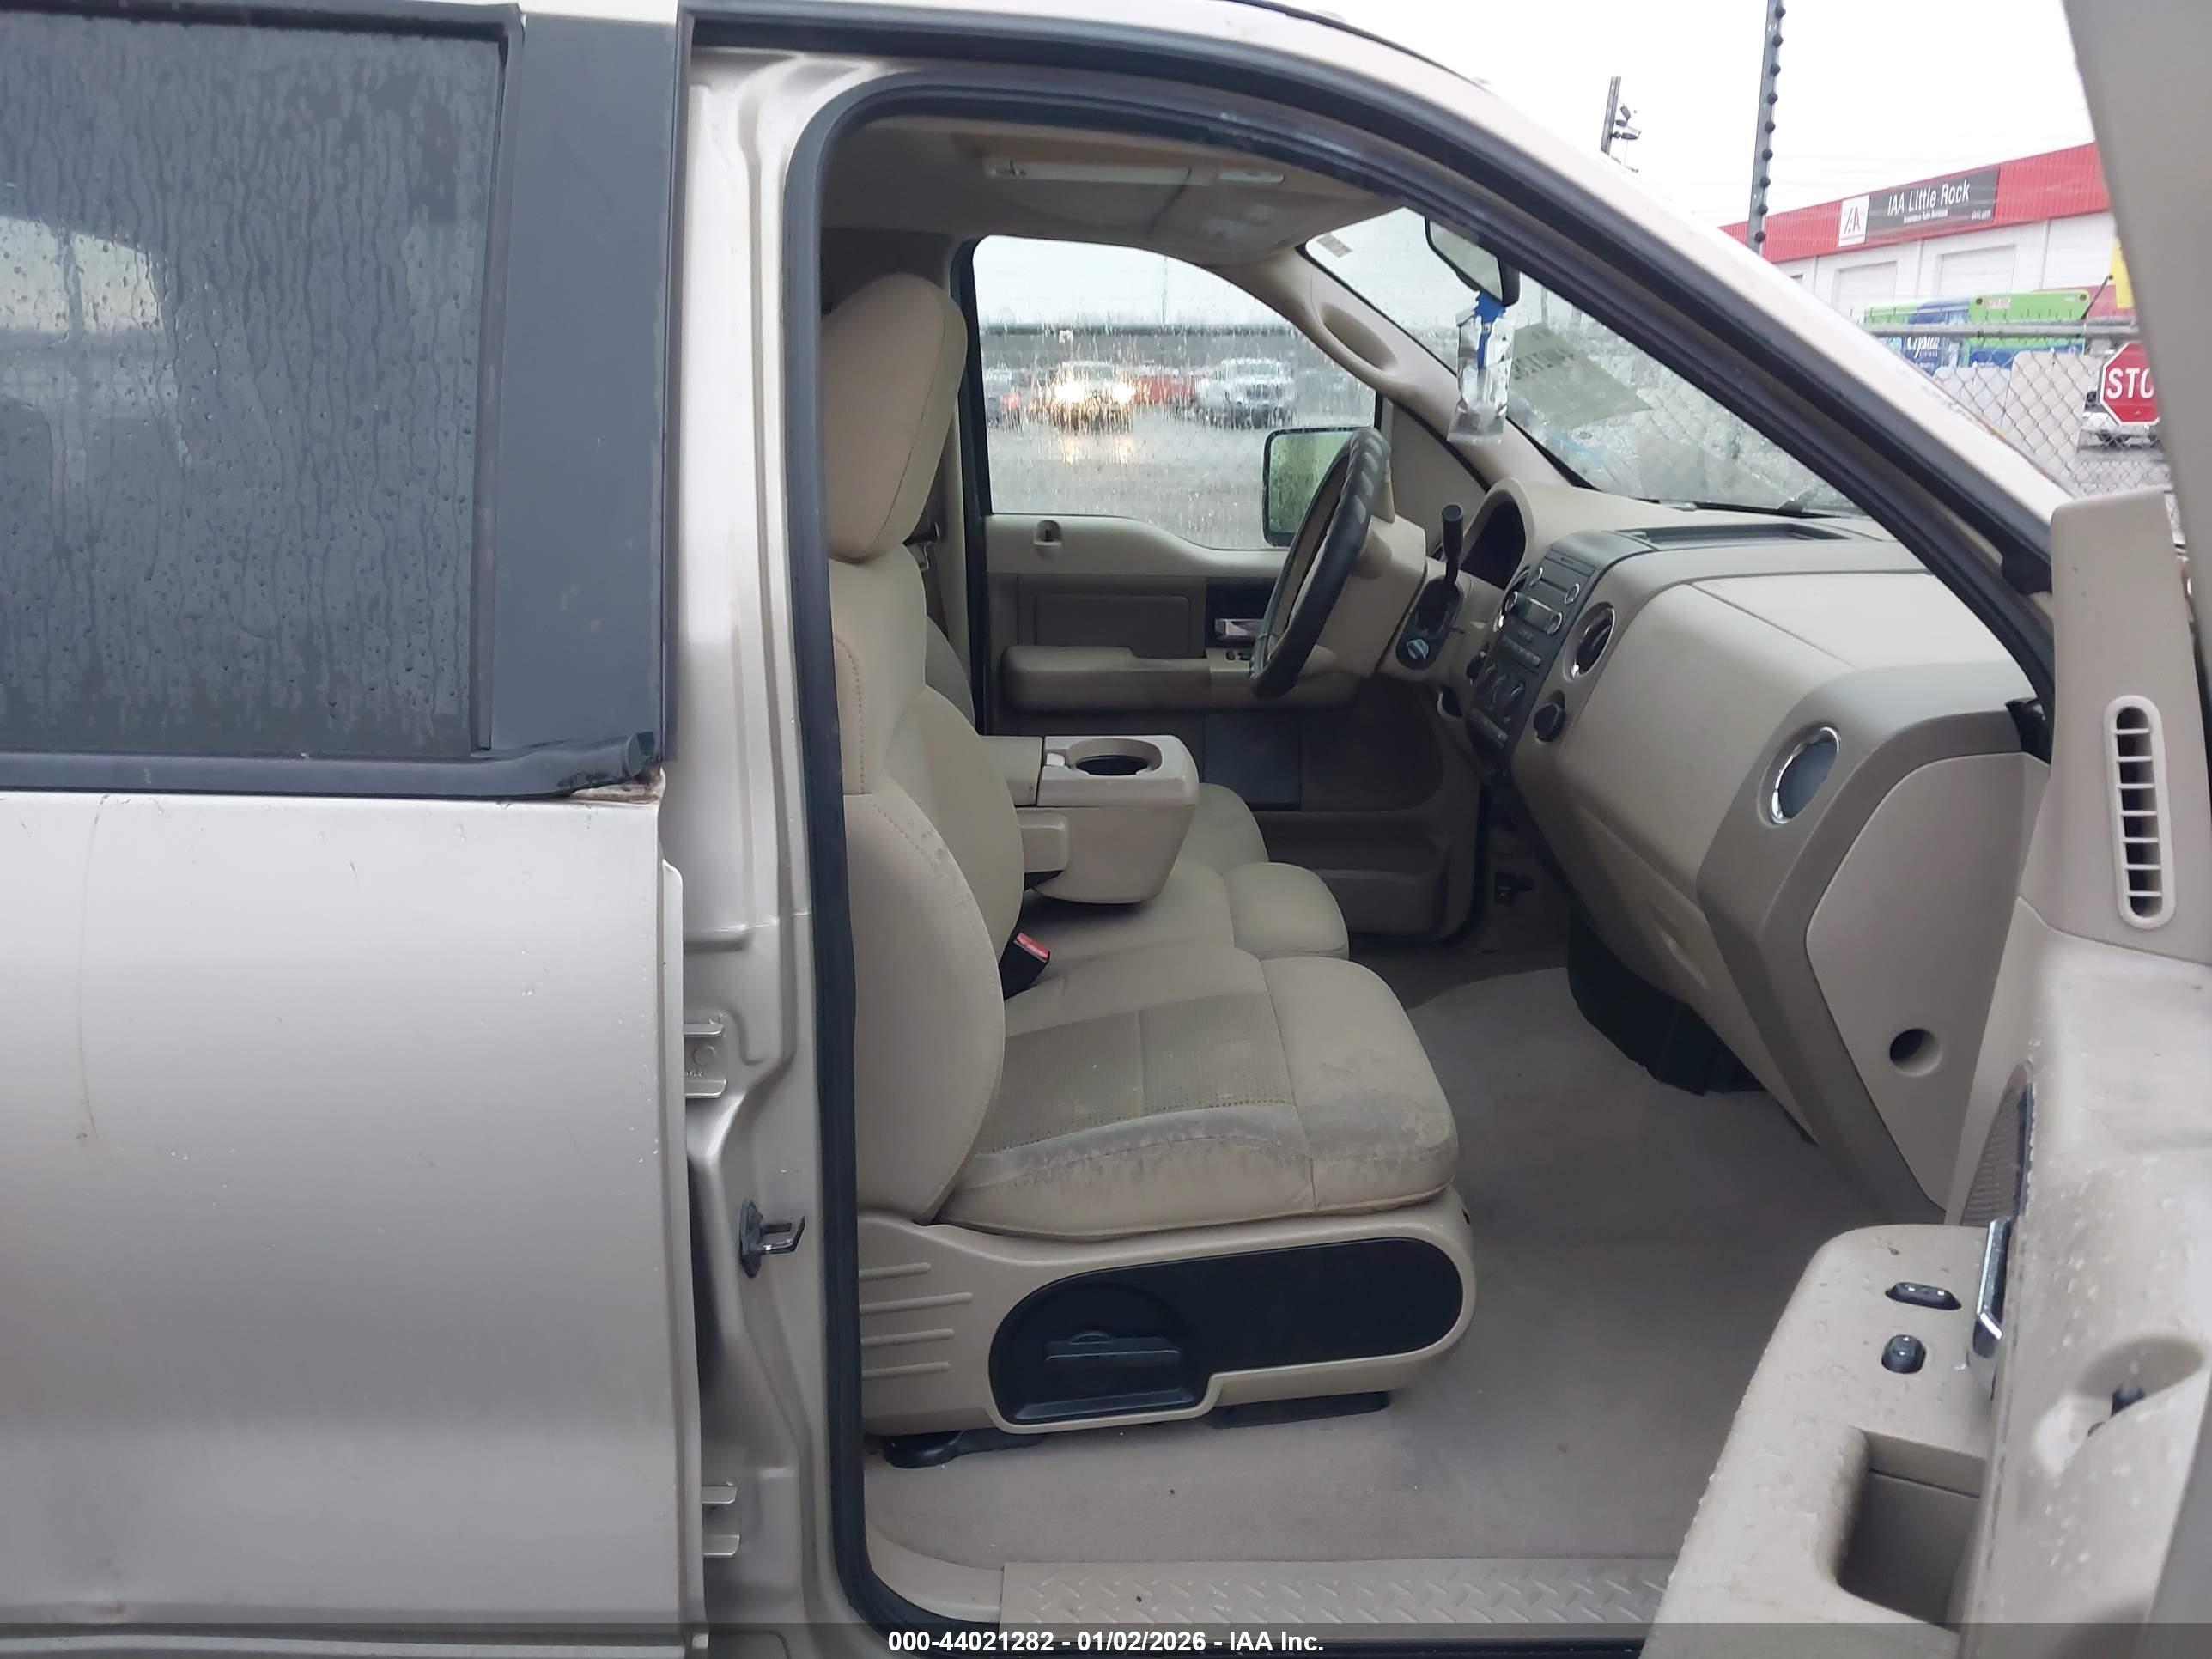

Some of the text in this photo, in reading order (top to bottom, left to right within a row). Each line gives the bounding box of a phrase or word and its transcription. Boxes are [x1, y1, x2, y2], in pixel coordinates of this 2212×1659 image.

[1888, 195, 1905, 216] IAA
[1909, 187, 1936, 212] Little
[1941, 179, 1970, 206] Rock
[2106, 368, 2154, 399] STO
